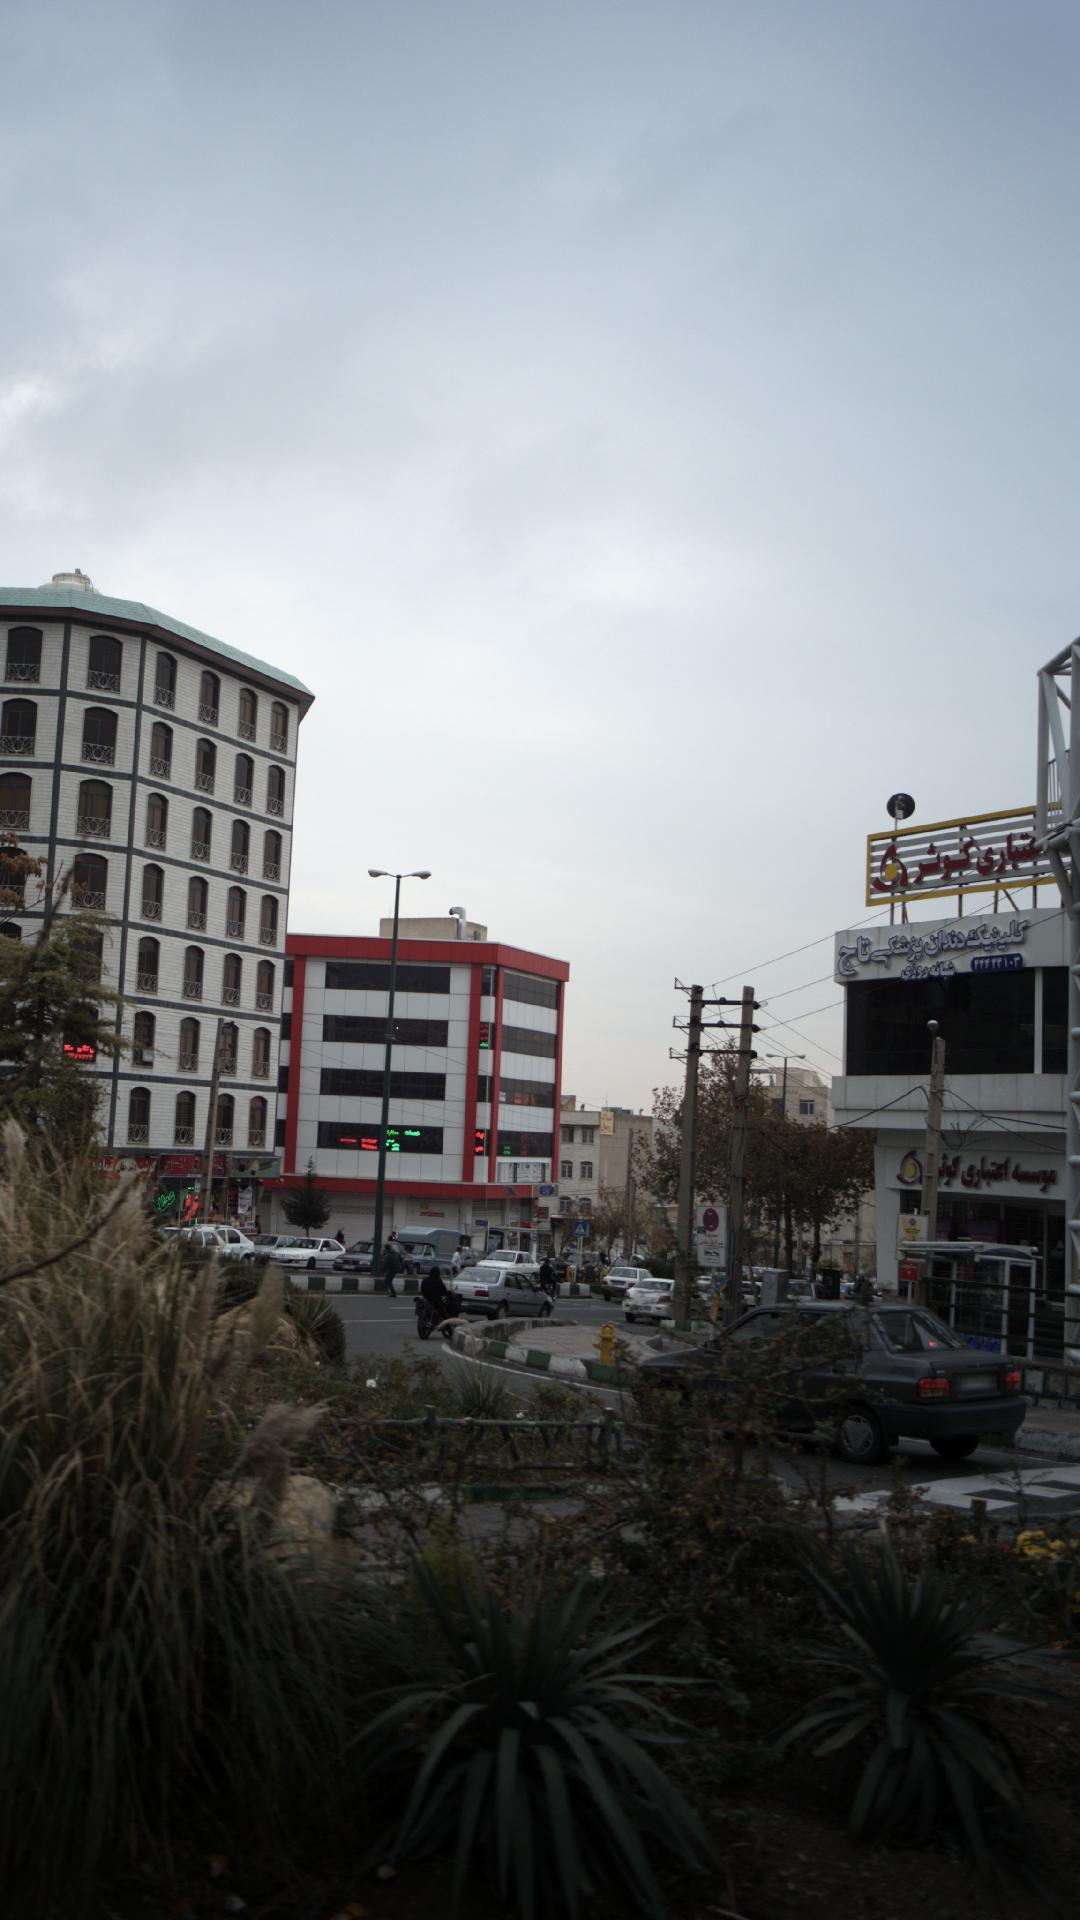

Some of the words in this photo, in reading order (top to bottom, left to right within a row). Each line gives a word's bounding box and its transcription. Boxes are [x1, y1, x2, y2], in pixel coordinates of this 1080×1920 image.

[966, 920, 1028, 951] کلینیک
[837, 935, 871, 976] تاج
[937, 1153, 961, 1186] کوث
[961, 1155, 1011, 1188] اعتباری
